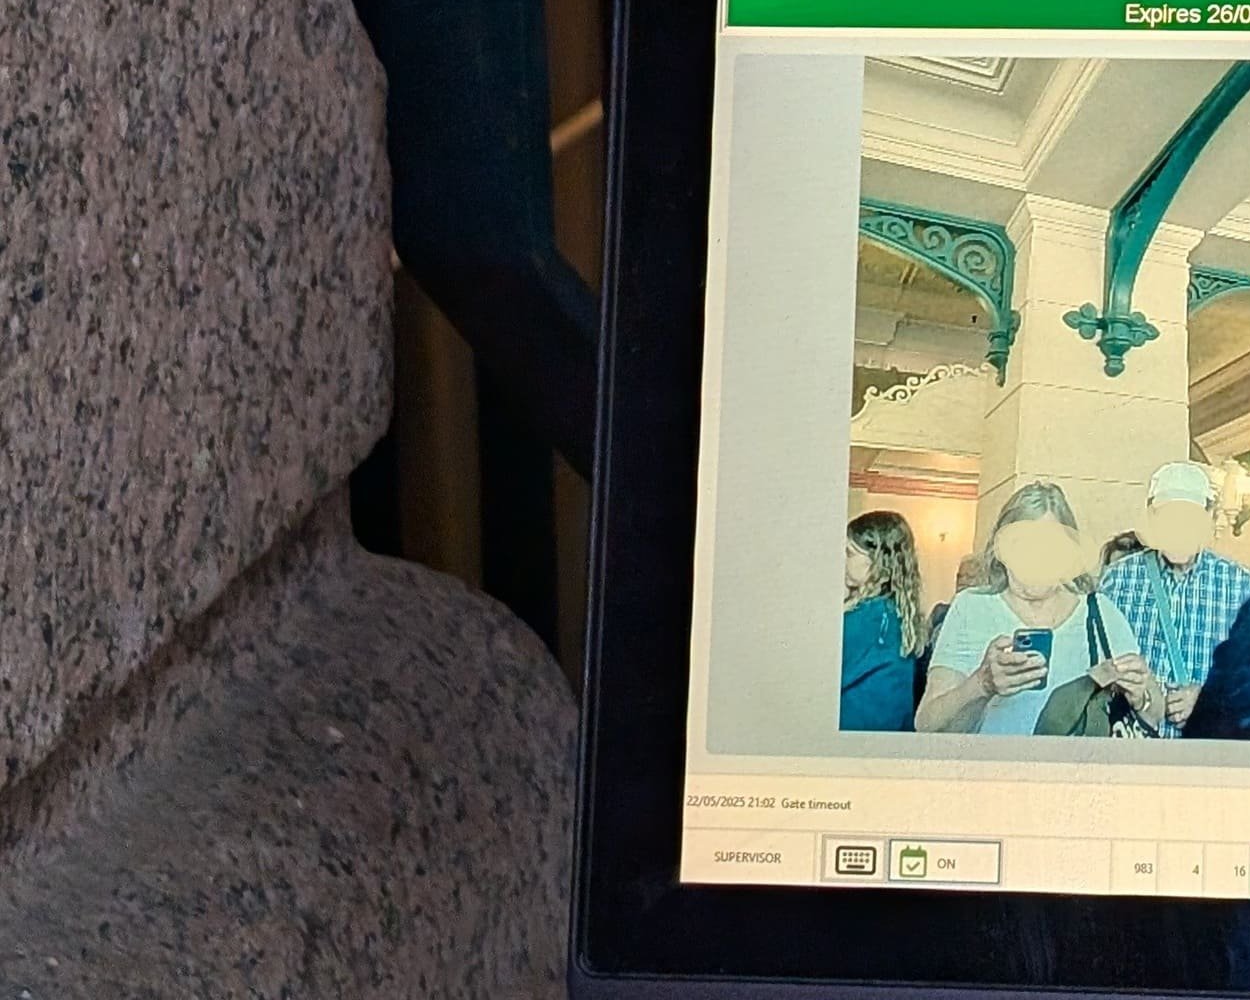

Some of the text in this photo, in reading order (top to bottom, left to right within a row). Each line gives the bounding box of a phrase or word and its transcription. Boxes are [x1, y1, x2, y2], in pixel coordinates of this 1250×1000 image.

[1125, 3, 1201, 26] Expires
[686, 795, 852, 811] 22/05/2025 21:02 Gate timeout
[713, 851, 782, 864] SUPERVISOR
[937, 858, 956, 870] ON
[1134, 862, 1153, 875] 983
[1192, 864, 1200, 875] 4
[1234, 865, 1246, 877] 16
